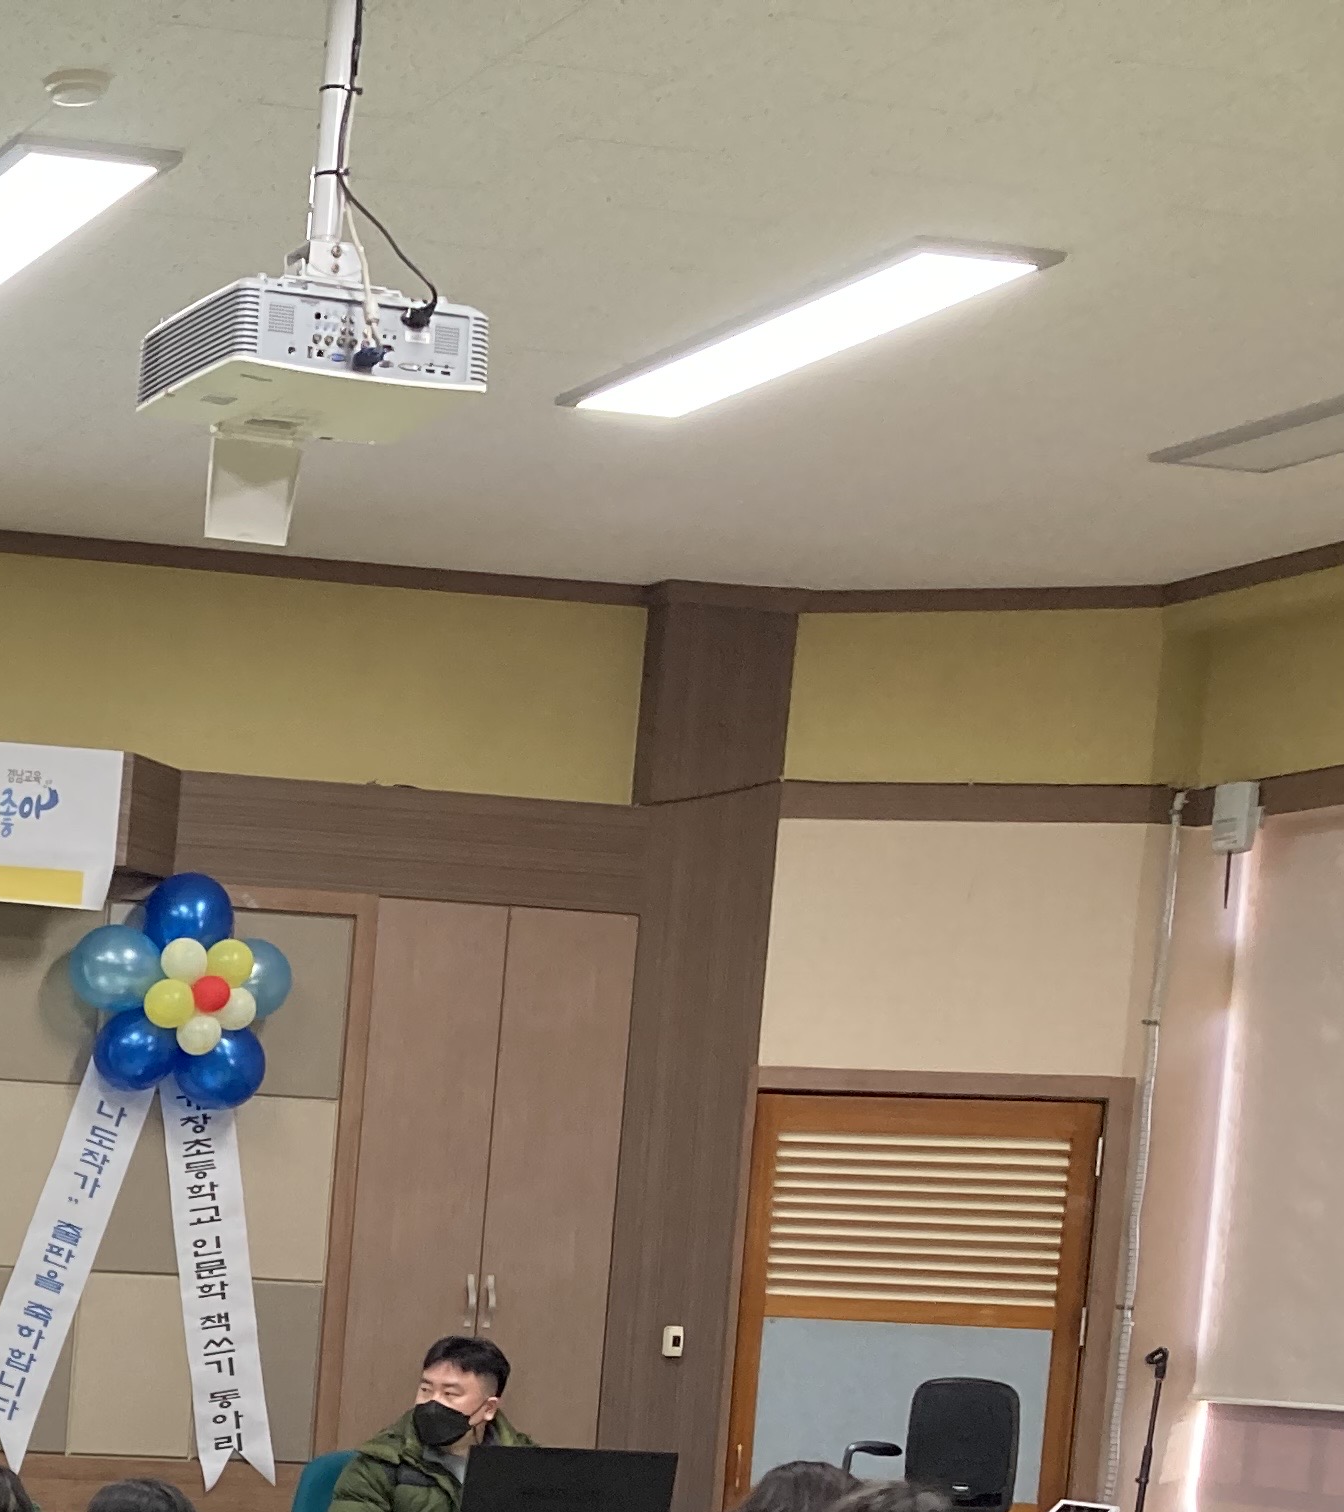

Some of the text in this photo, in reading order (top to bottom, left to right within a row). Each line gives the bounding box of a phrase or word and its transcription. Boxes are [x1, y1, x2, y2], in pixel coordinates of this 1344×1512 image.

[34, 1219, 84, 1295] 출판을
[192, 1235, 230, 1300] 인문학
[207, 1388, 245, 1452] 동아리
